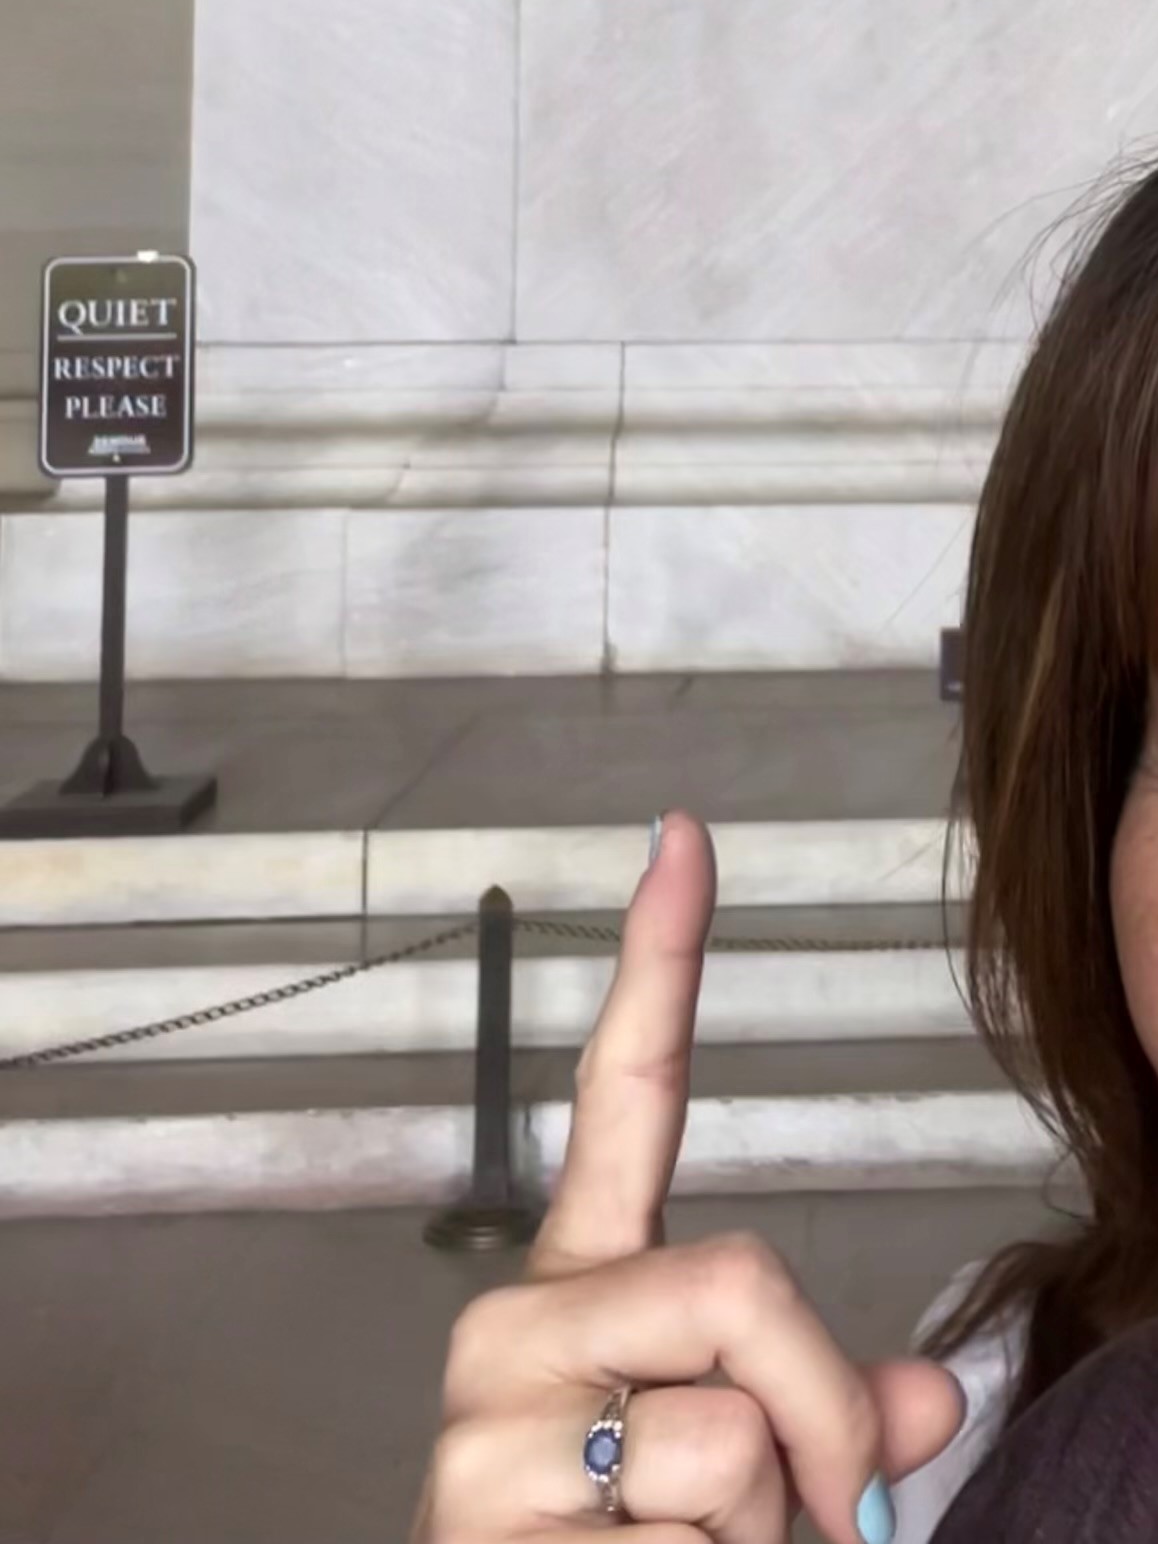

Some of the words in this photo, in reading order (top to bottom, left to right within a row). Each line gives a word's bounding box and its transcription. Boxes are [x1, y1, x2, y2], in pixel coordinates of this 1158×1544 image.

[57, 298, 178, 335] QUIET
[54, 355, 179, 380] RESPECT
[65, 395, 167, 419] PLEASE
